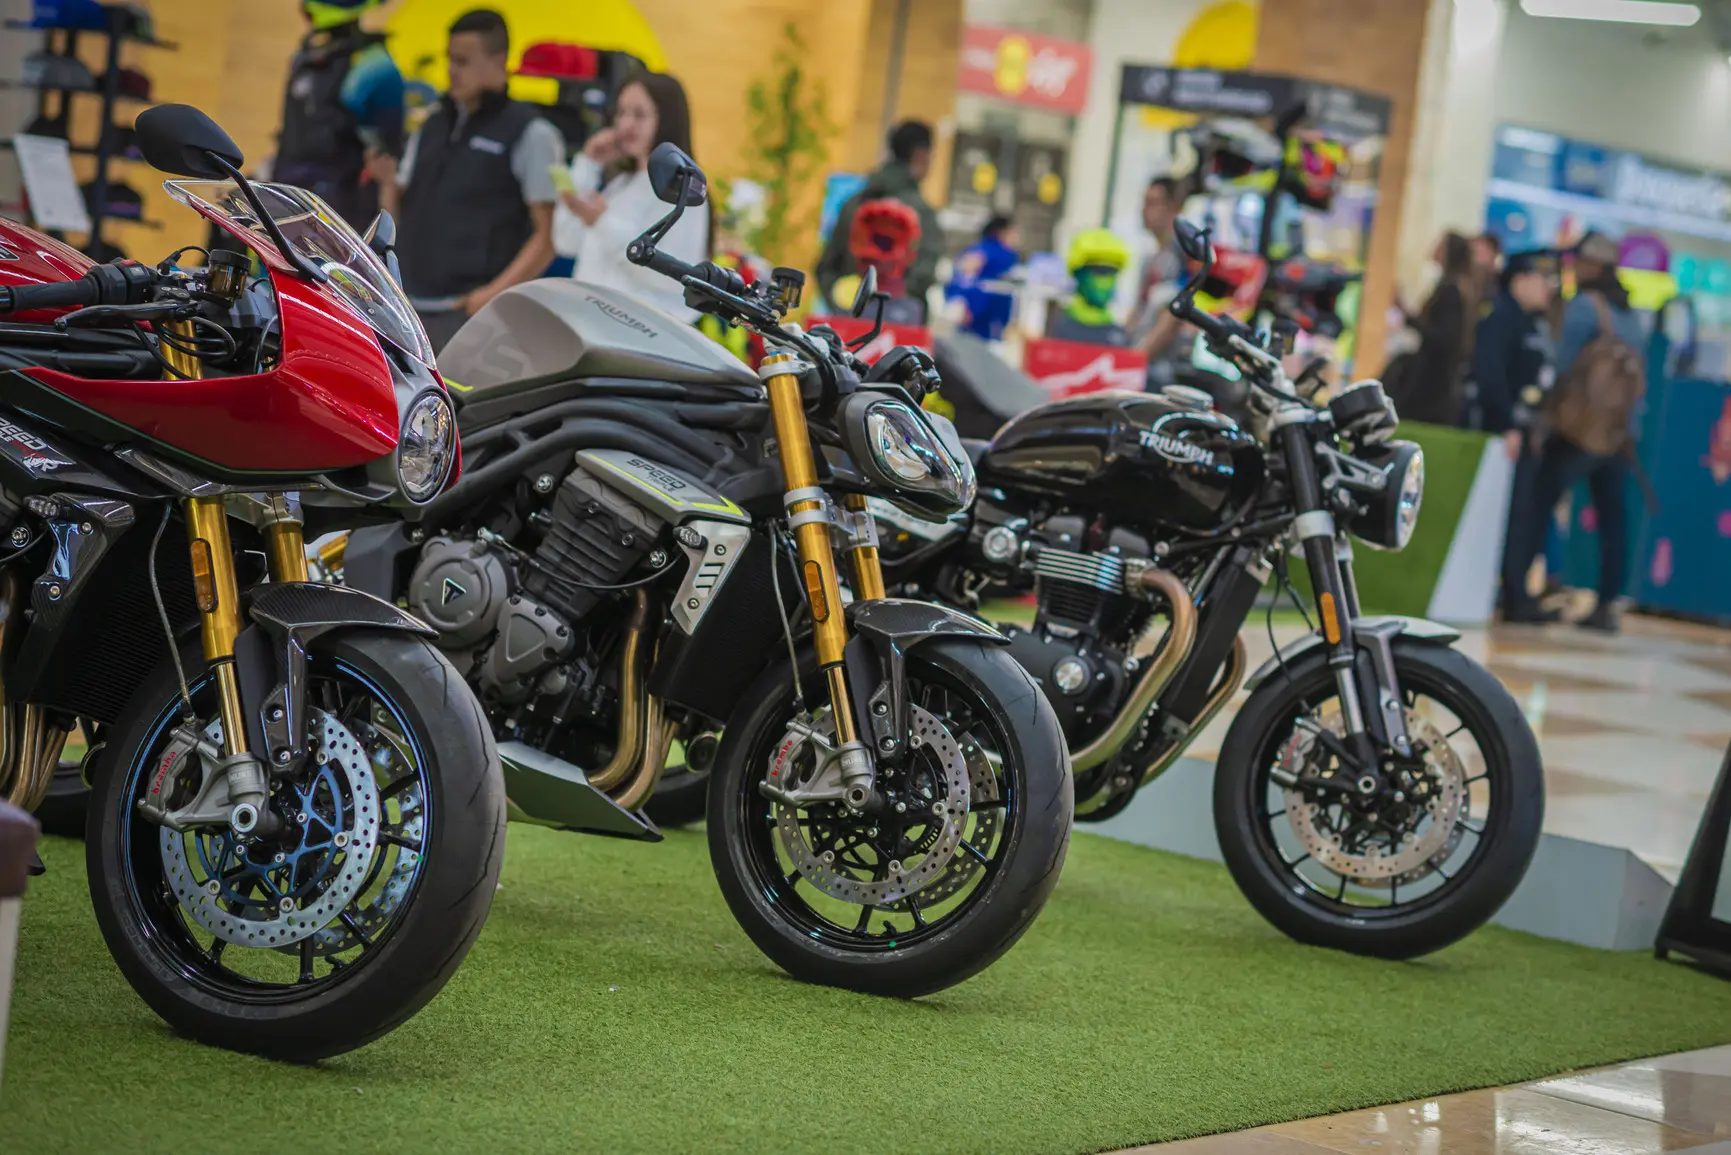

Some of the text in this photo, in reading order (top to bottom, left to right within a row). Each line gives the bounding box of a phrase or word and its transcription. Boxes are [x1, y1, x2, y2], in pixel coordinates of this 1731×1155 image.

[584, 295, 658, 338] TRIUMPH
[0, 416, 48, 450] PEED
[1139, 430, 1214, 465] TRIUMPH
[626, 458, 686, 489] SPEED
[152, 751, 176, 795] brembo
[772, 740, 793, 777] brembo
